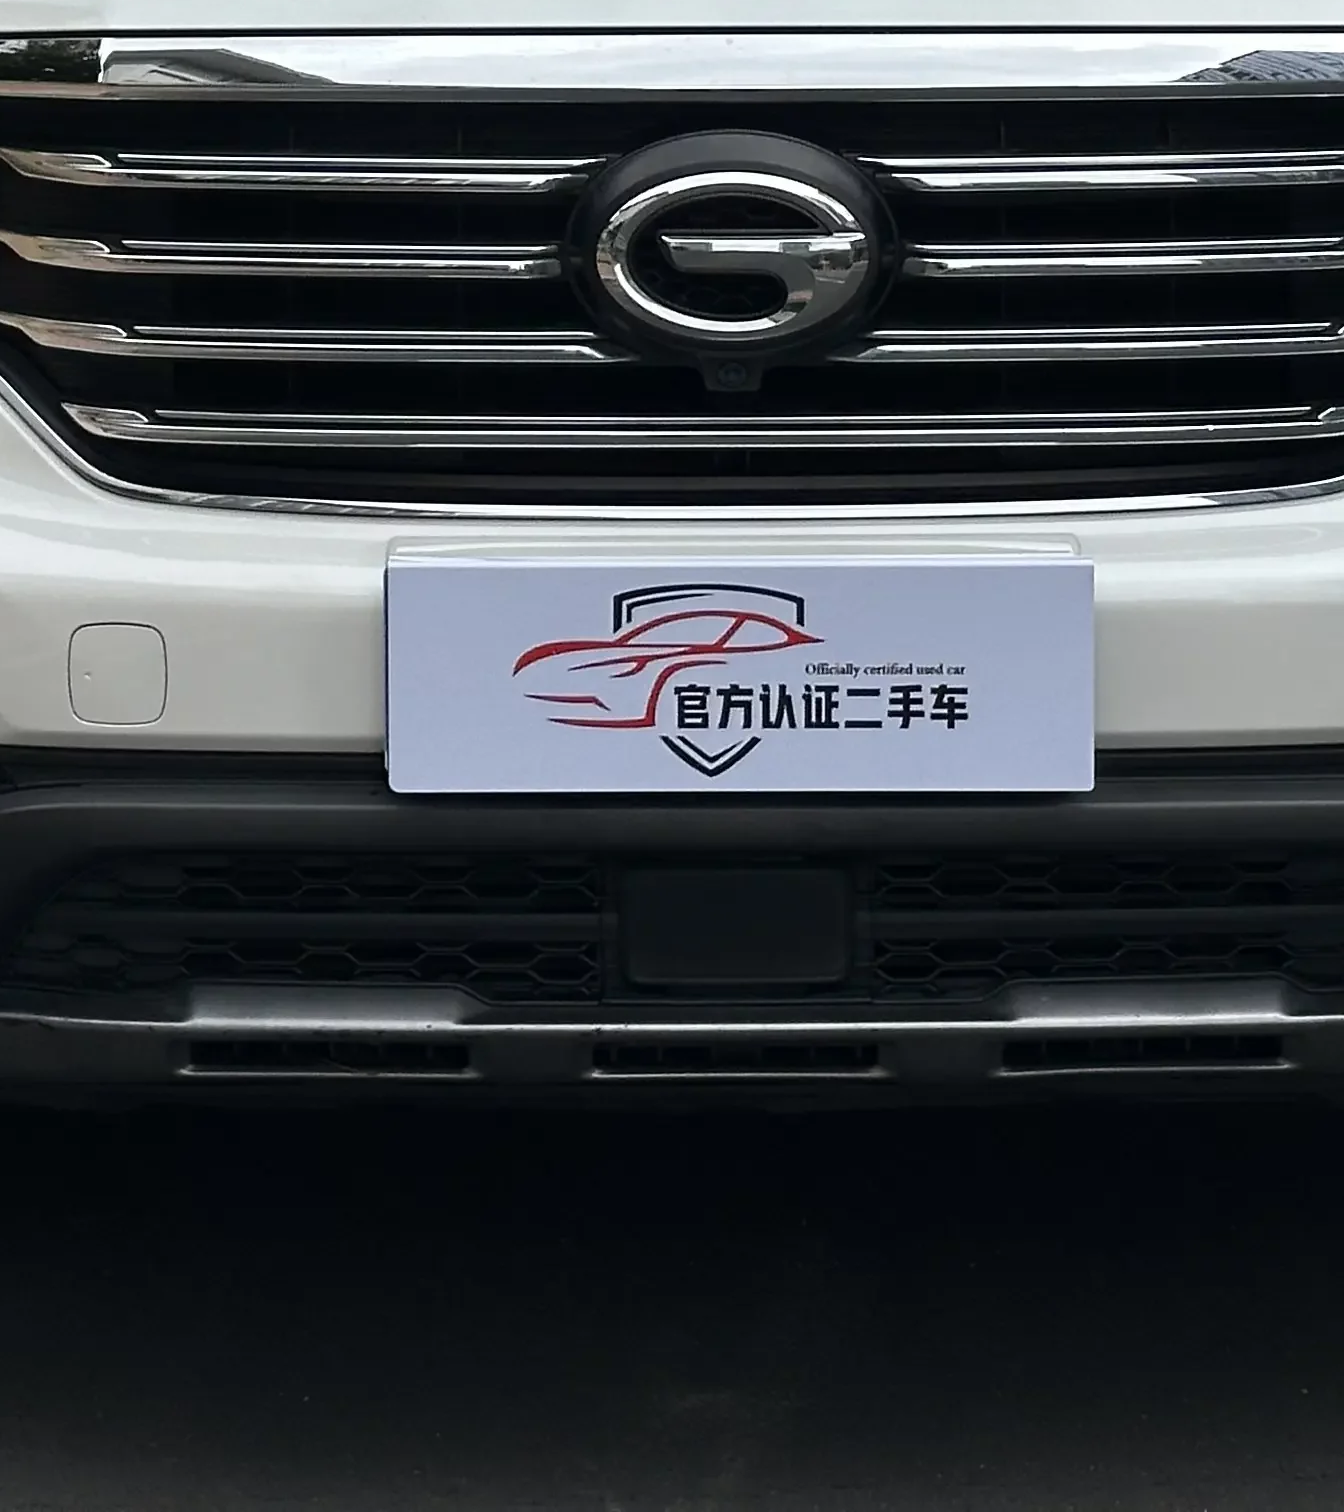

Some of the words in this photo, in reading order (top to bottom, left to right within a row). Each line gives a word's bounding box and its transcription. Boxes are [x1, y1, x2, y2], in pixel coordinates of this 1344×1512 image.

[805, 663, 860, 678] Officially
[863, 663, 913, 675] certified
[916, 663, 944, 675] used
[946, 666, 966, 675] car
[674, 683, 969, 729] 官方认证二手车
